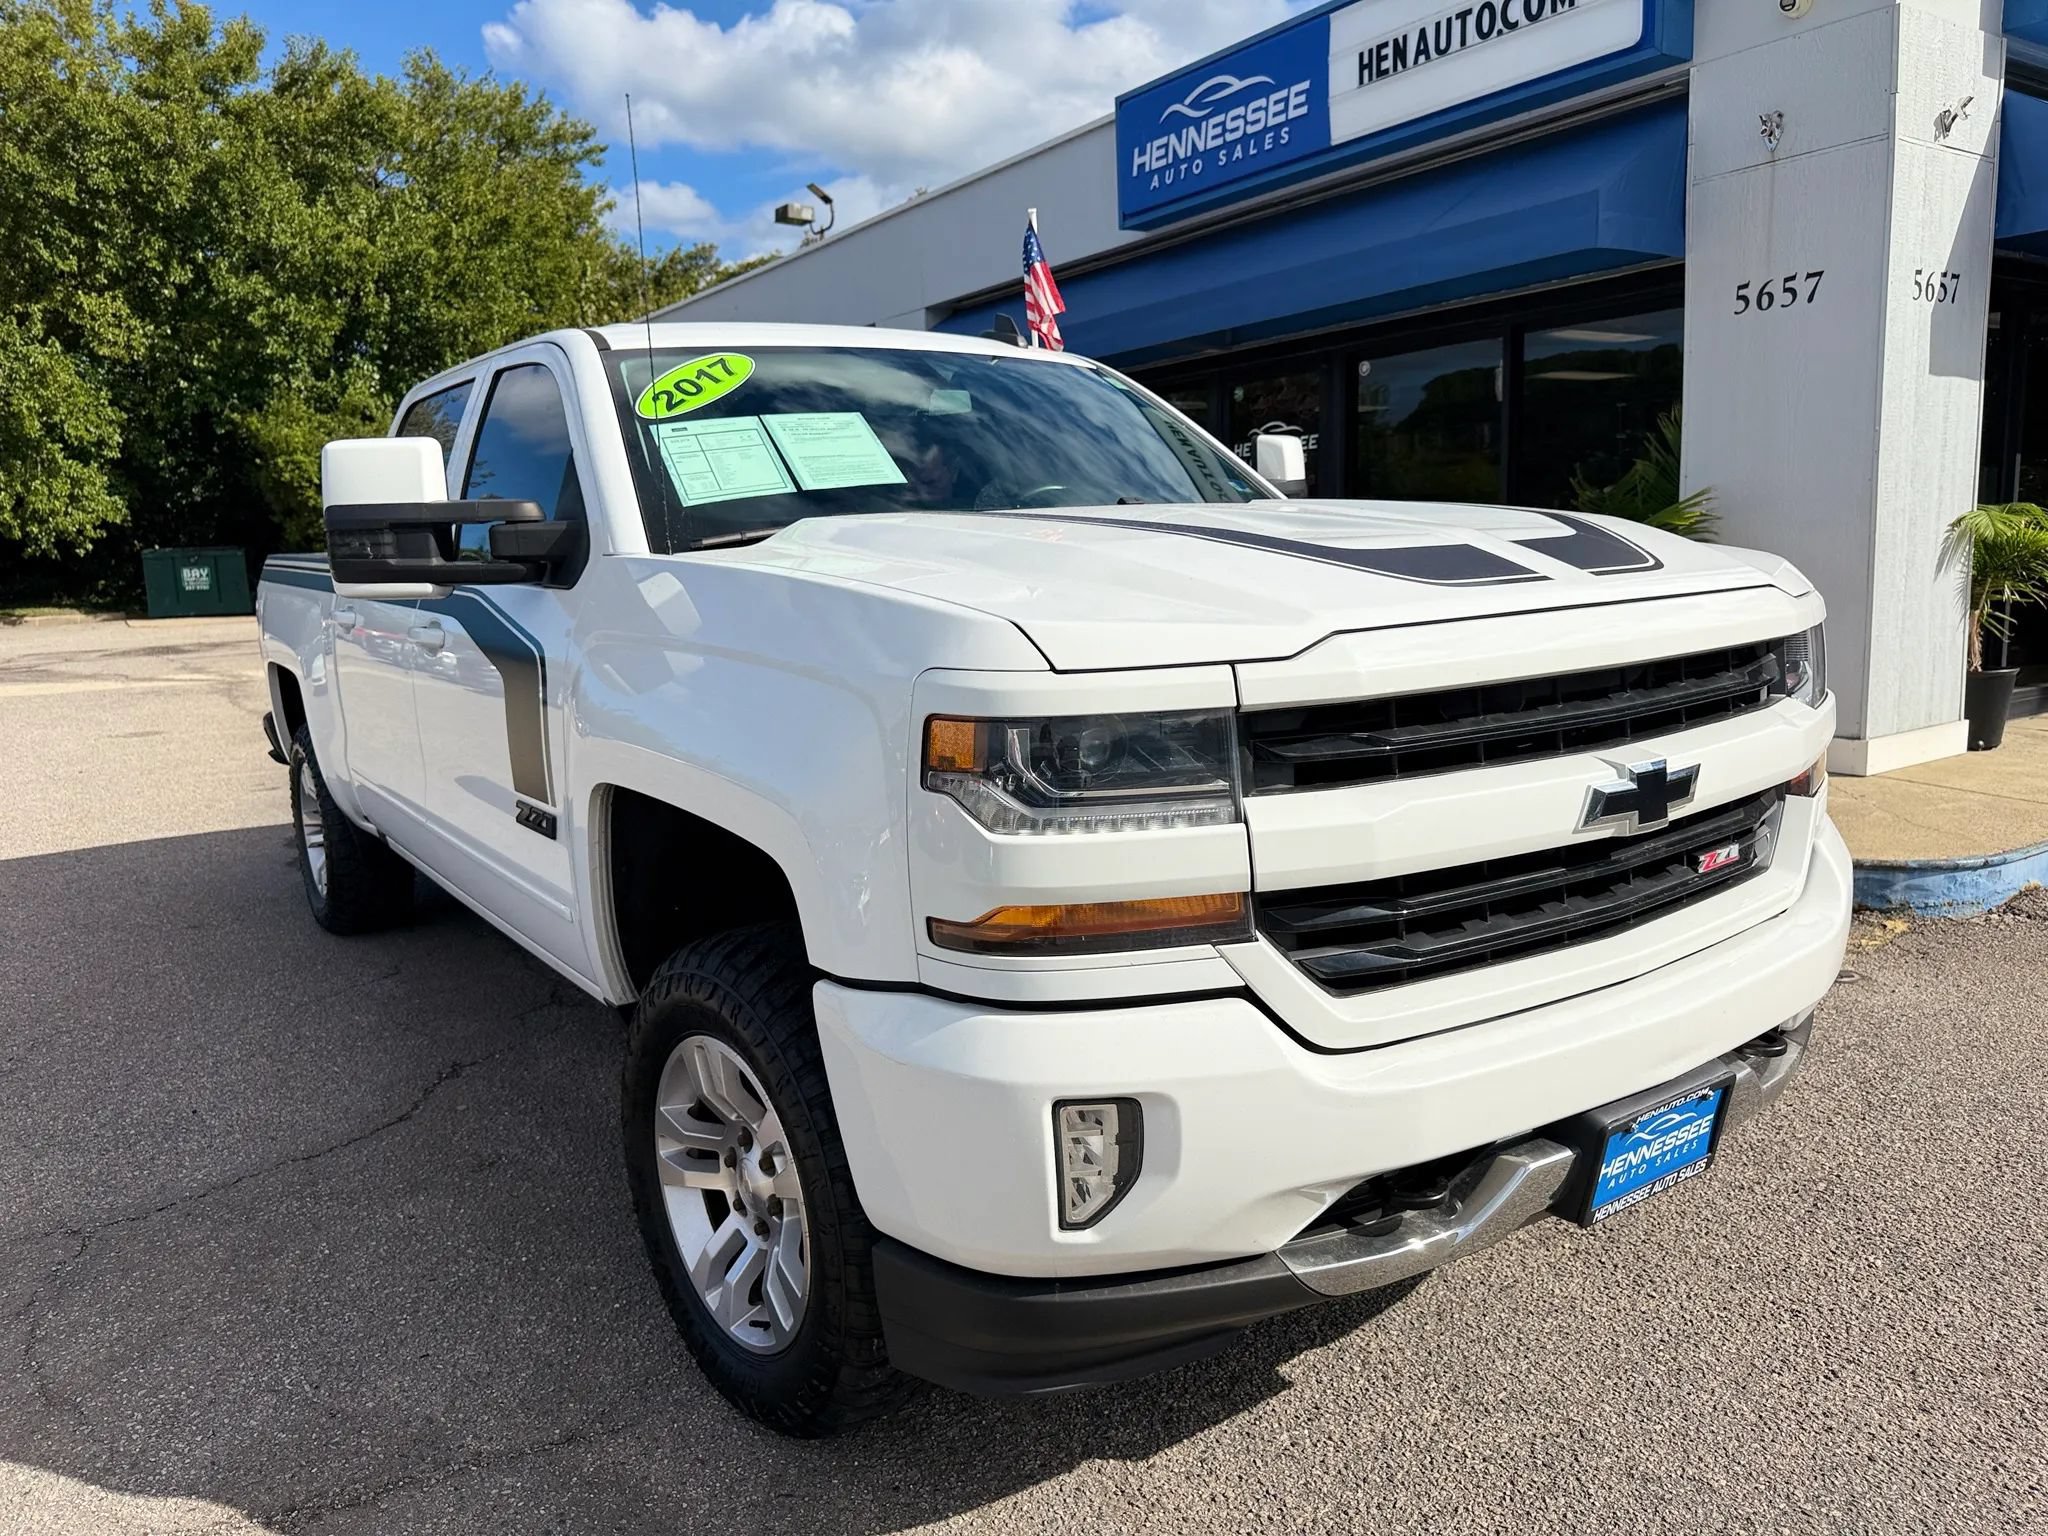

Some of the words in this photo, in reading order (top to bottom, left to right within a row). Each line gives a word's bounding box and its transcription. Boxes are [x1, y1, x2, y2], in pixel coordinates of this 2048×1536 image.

[1131, 80, 1311, 177] HENNESSEE
[1149, 158, 1203, 190] AUTO
[1218, 127, 1290, 168] SALES
[1734, 270, 1825, 316] 5657
[1912, 268, 1961, 305] 5657
[652, 357, 735, 413] 2017
[1636, 1086, 1710, 1124] HENAUTO.COM
[1598, 1113, 1716, 1183] HENNESSEE
[1607, 1165, 1647, 1190] AUTO
[1656, 1141, 1698, 1166] SALES
[1592, 1184, 1653, 1224] HENNESSEE
[1650, 1173, 1680, 1196] AUTO
[1677, 1157, 1708, 1181] SALES
